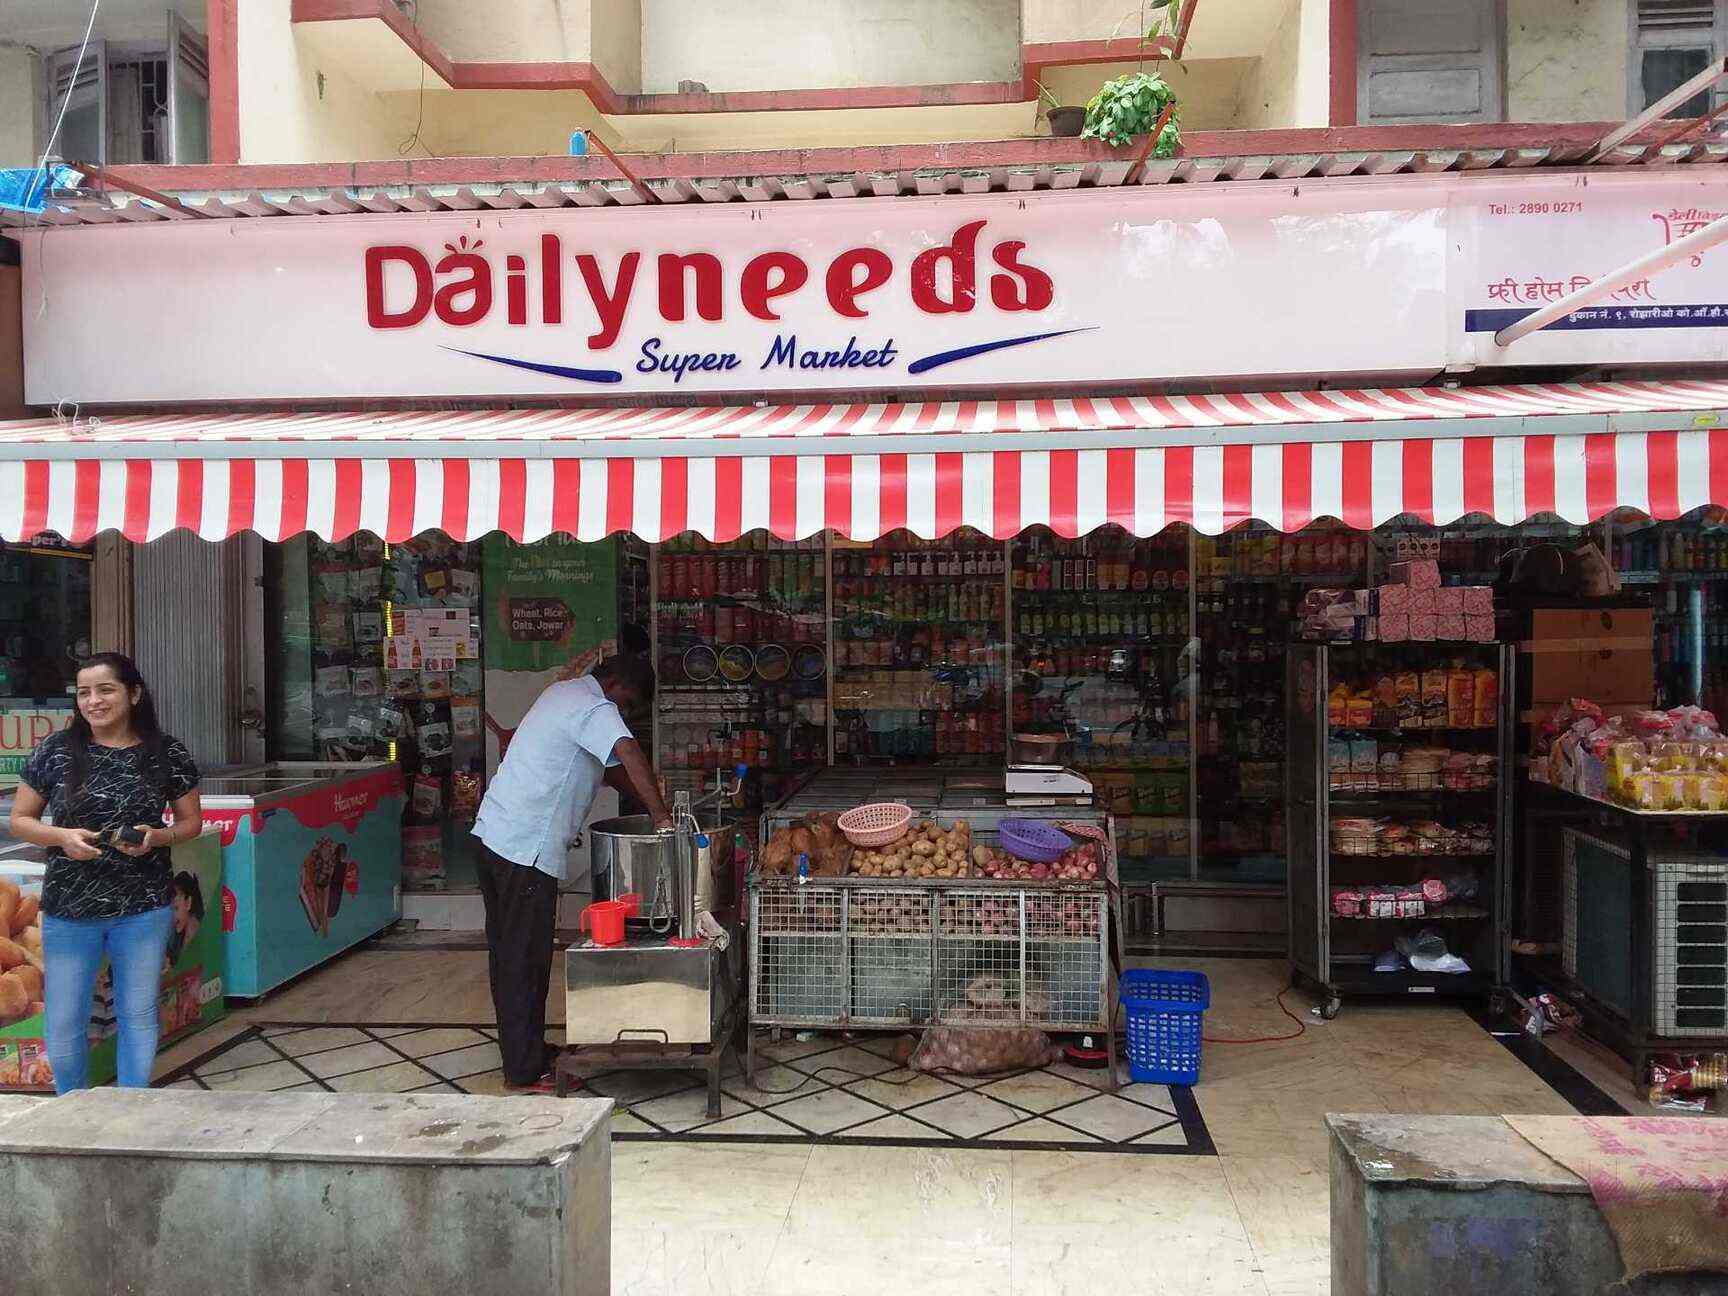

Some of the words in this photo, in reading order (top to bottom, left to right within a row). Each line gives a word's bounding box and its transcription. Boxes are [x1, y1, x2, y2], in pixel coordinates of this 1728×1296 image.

[1519, 202, 1549, 214] 2890
[1553, 201, 1583, 213] 0271
[364, 220, 1054, 349] Dailyneeds
[635, 337, 741, 384] Super
[760, 334, 899, 371] Market
